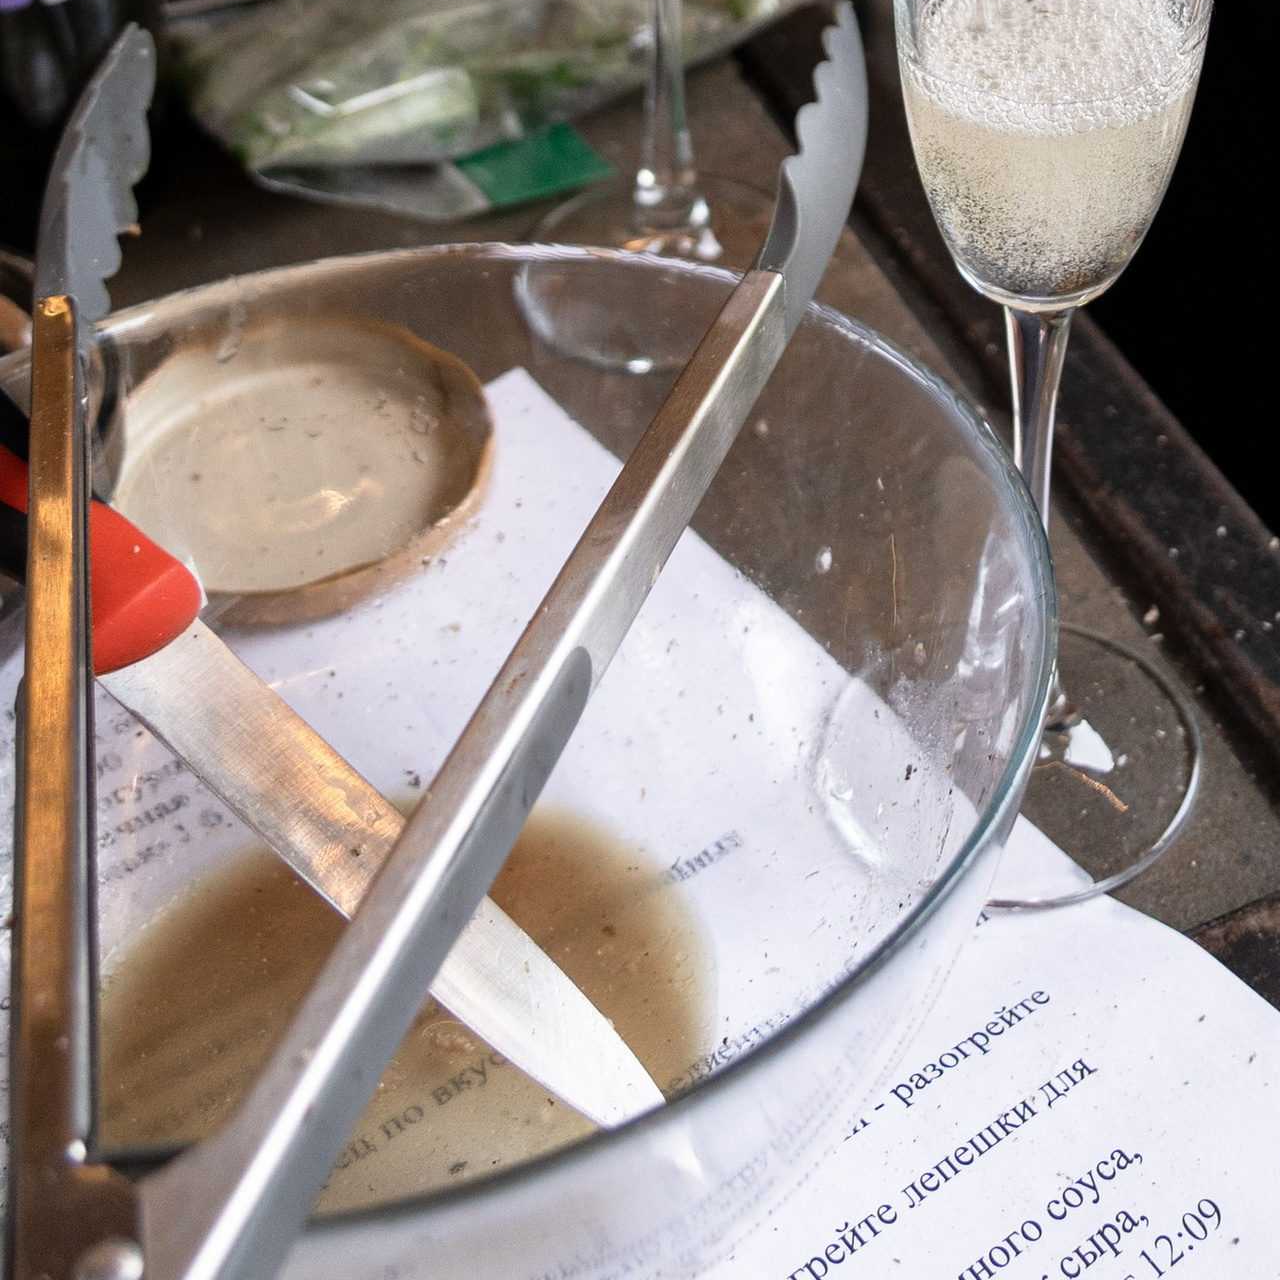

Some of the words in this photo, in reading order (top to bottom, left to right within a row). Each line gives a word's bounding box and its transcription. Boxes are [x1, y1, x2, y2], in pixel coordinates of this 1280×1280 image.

[888, 990, 1051, 1108] разогрейте
[378, 1104, 424, 1139] по
[900, 1098, 1039, 1209] лепешки
[1038, 1058, 1098, 1109] для
[957, 1220, 1043, 1280] ного
[1046, 1147, 1144, 1221] соуса,
[1059, 1209, 1150, 1280] сыра,
[1138, 1197, 1223, 1280] 12:09
